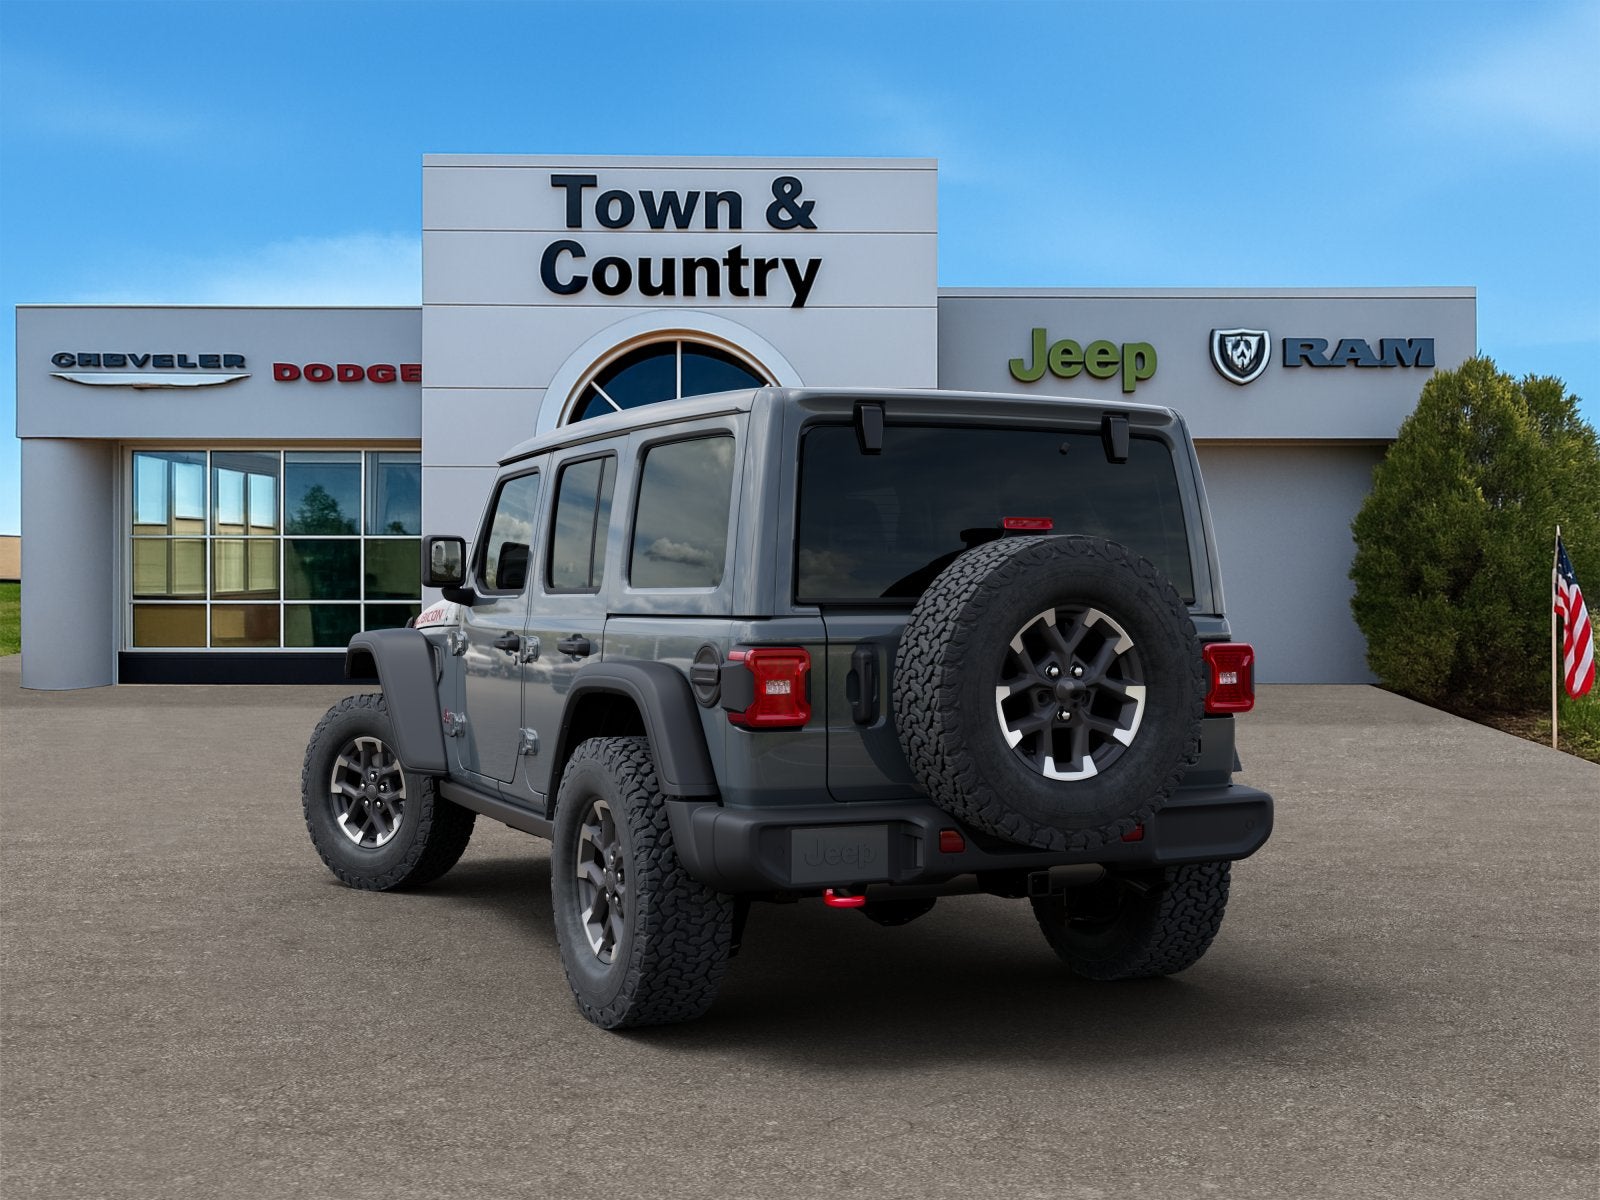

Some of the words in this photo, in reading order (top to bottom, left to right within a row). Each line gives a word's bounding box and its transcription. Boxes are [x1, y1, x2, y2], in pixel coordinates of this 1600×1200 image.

[550, 174, 742, 230] Town
[765, 176, 818, 230] &
[540, 239, 822, 308] Country
[272, 363, 422, 383] DODGE
[1009, 328, 1157, 392] Jeep
[1282, 337, 1436, 368] RAM
[804, 838, 877, 870] Jeep
